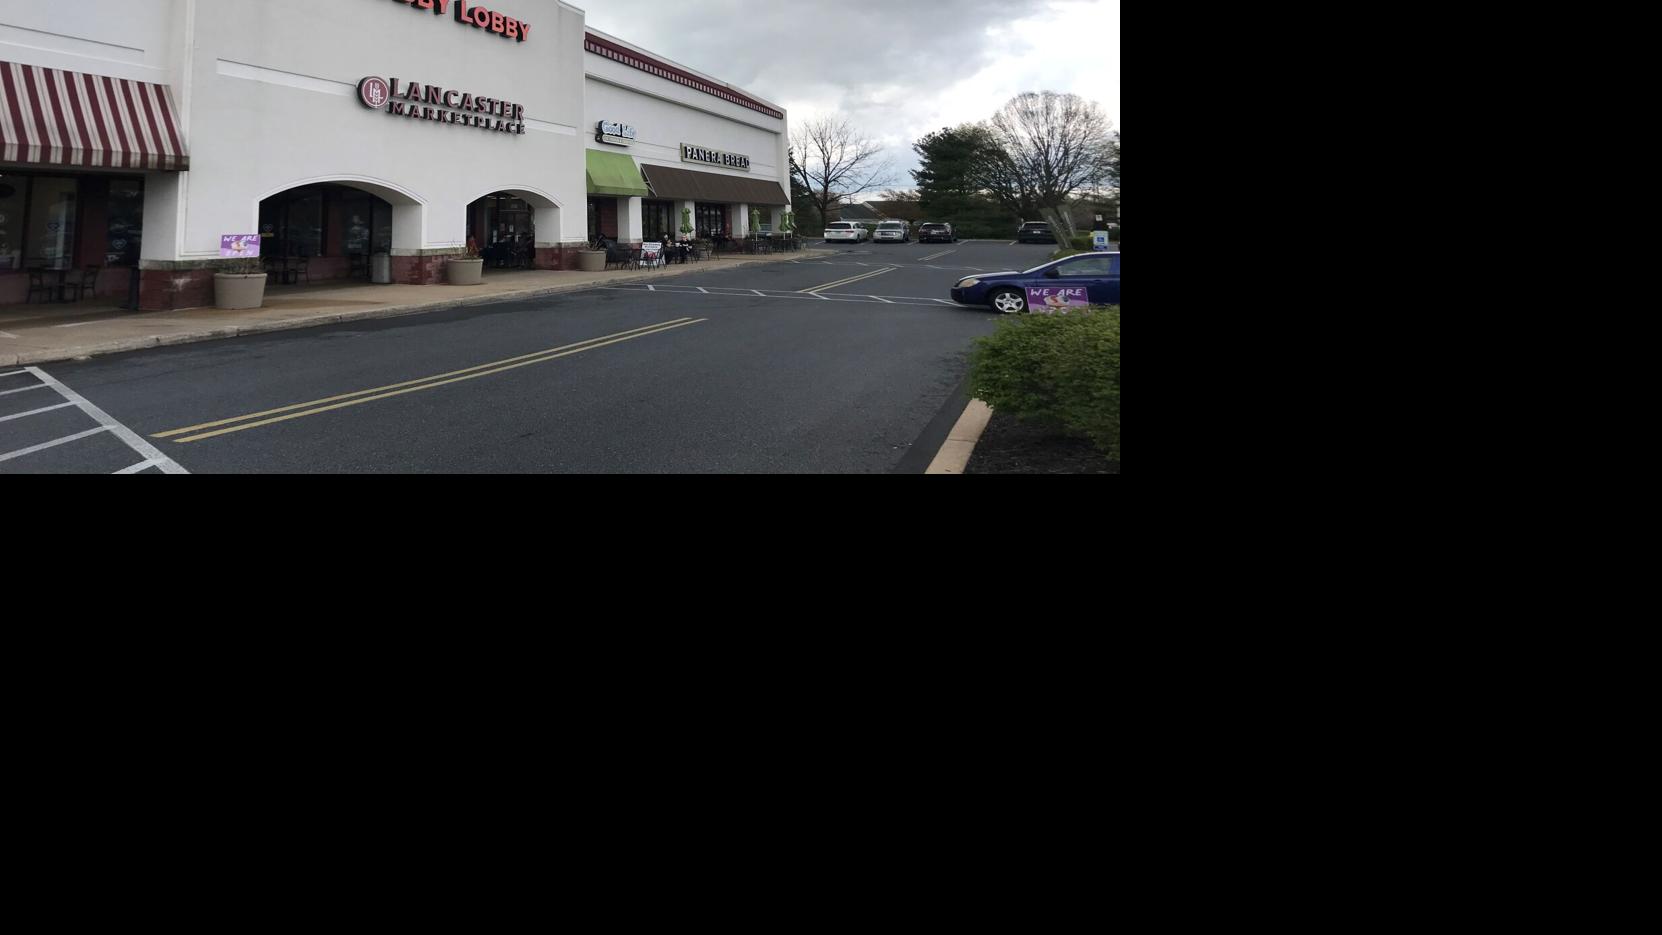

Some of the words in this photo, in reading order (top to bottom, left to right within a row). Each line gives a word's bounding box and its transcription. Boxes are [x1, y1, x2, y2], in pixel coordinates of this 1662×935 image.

[454, 0, 531, 42] LOBBY
[389, 77, 525, 121] LANCASTER
[387, 101, 526, 135] MARKETPLACE
[684, 146, 721, 164] PANERA
[723, 153, 750, 169] BREAD
[1030, 288, 1050, 296] WE
[1057, 288, 1083, 296] ARE
